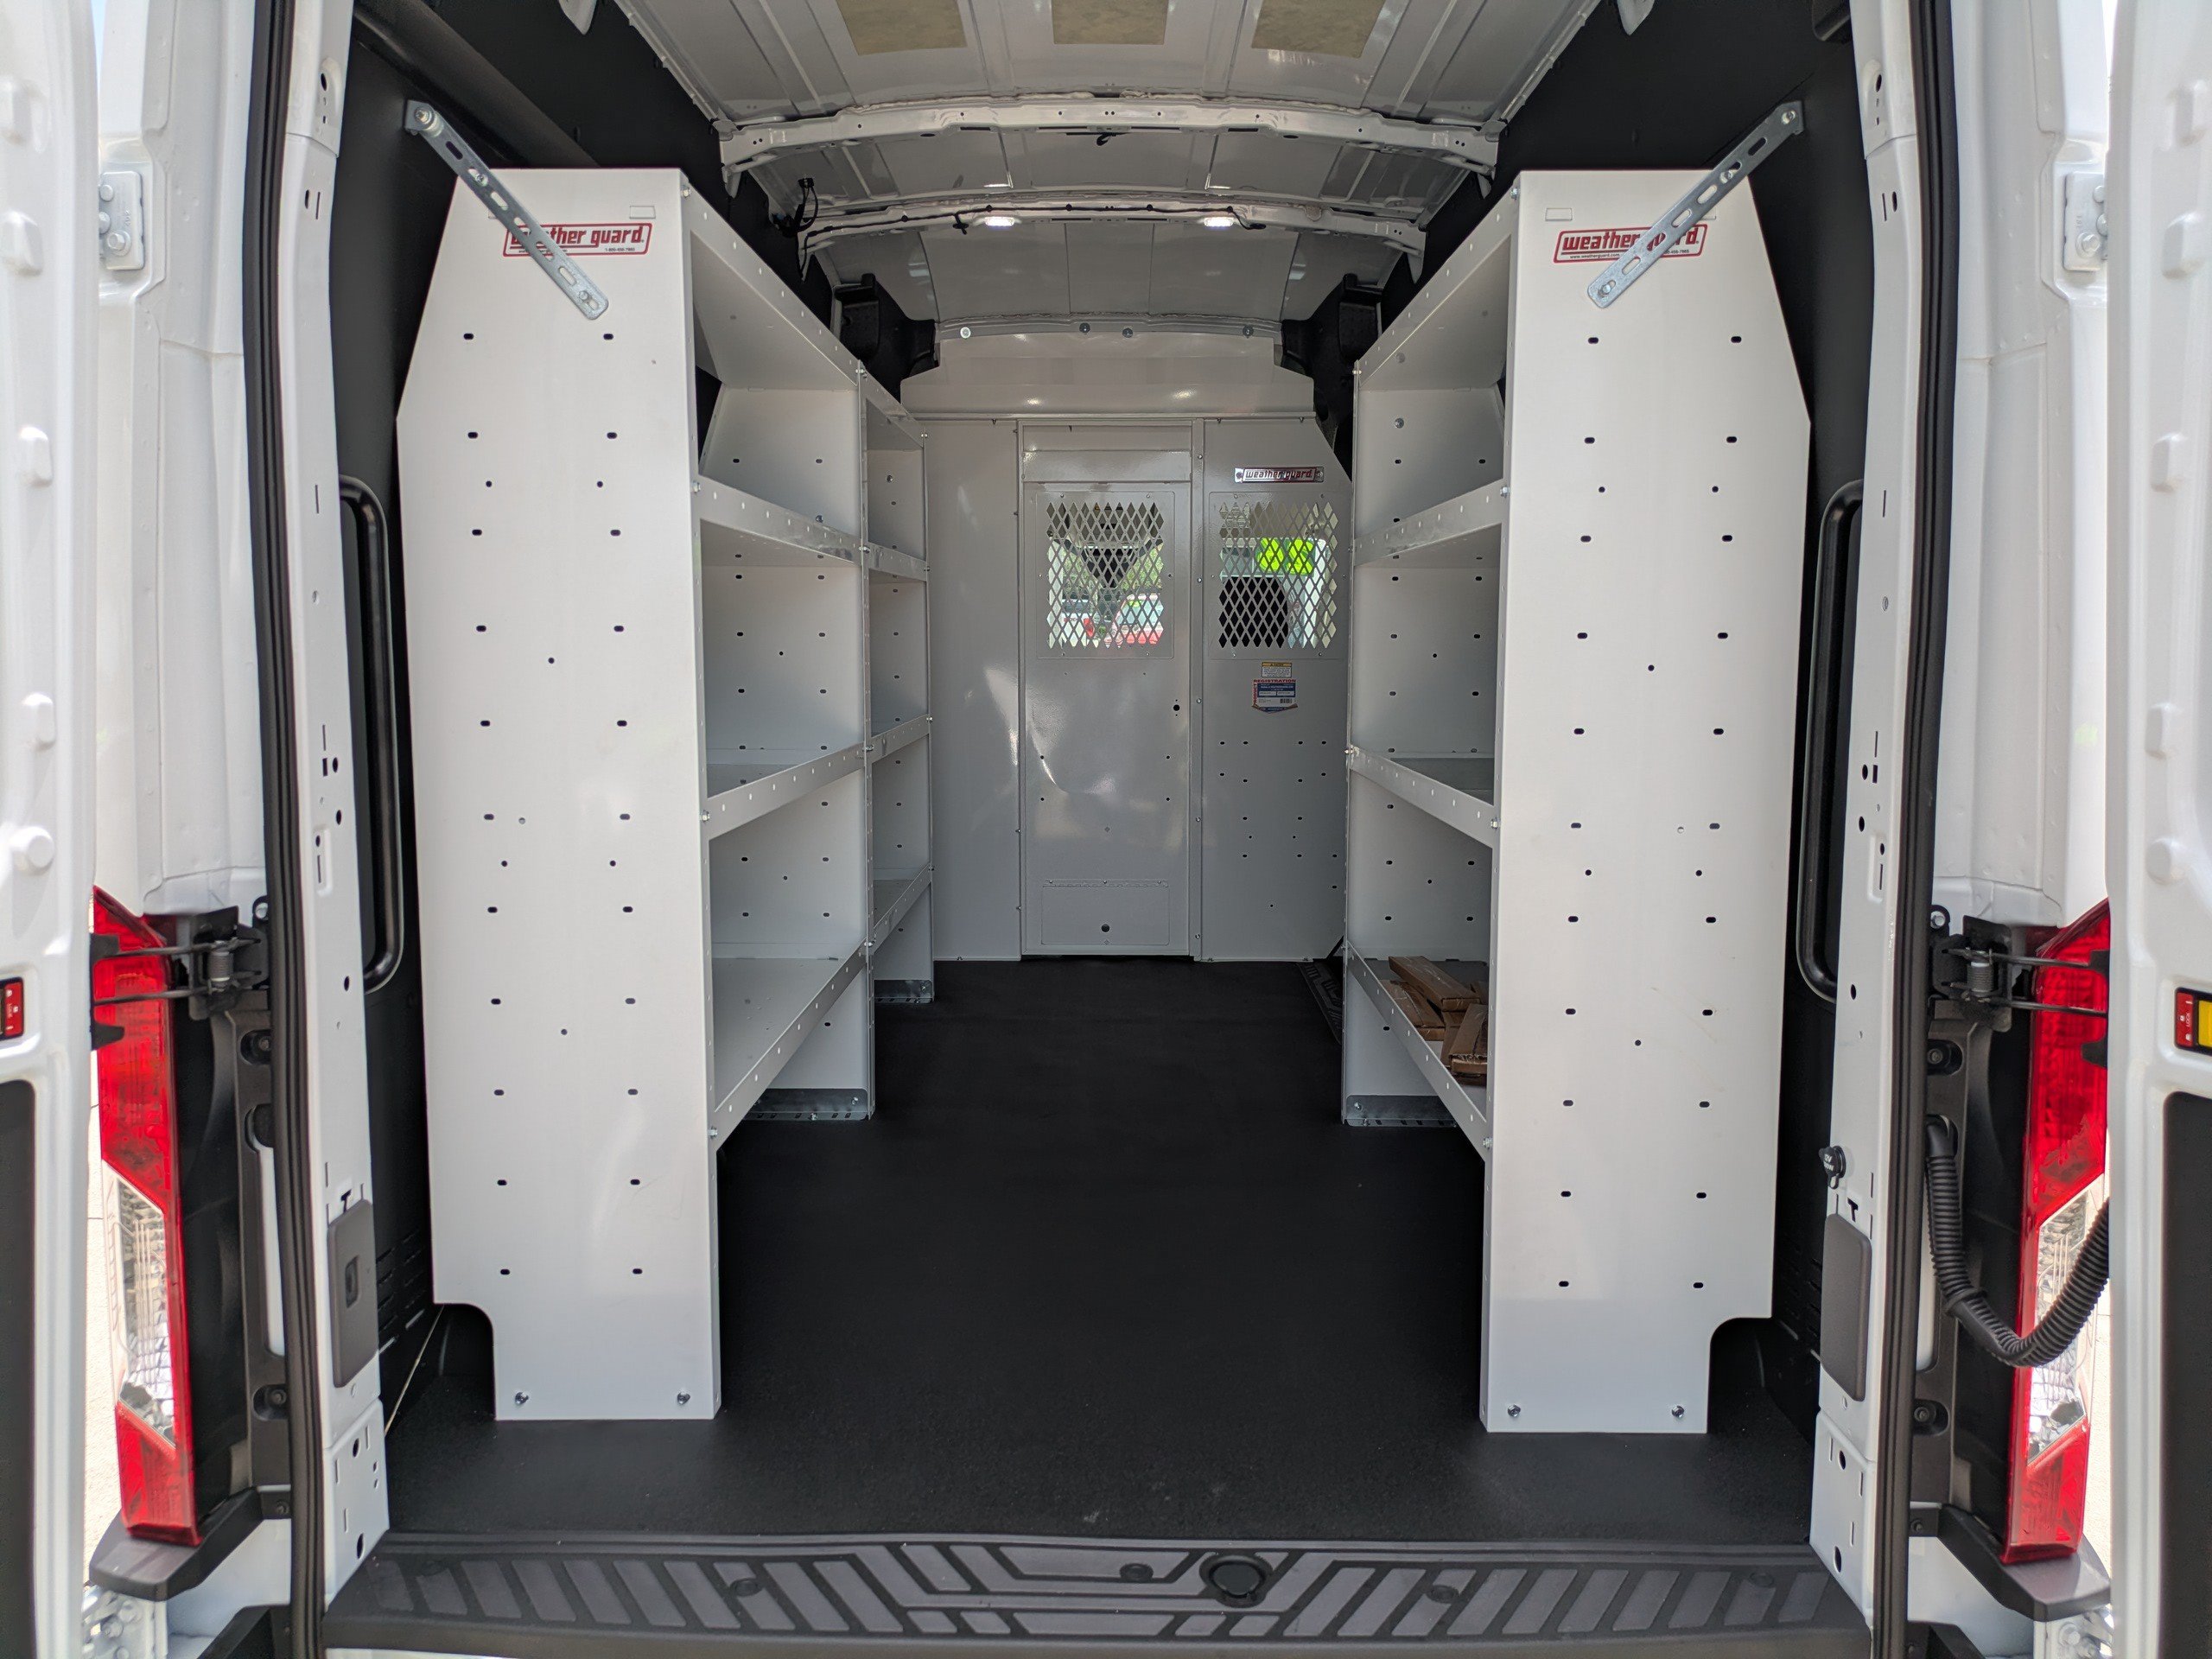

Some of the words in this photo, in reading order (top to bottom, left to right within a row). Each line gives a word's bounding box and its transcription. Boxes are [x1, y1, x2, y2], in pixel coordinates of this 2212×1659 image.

[511, 226, 587, 245] ther
[590, 226, 644, 248] guard
[1561, 229, 1641, 251] weather
[1245, 469, 1285, 479] weather
[1285, 469, 1313, 480] guard
